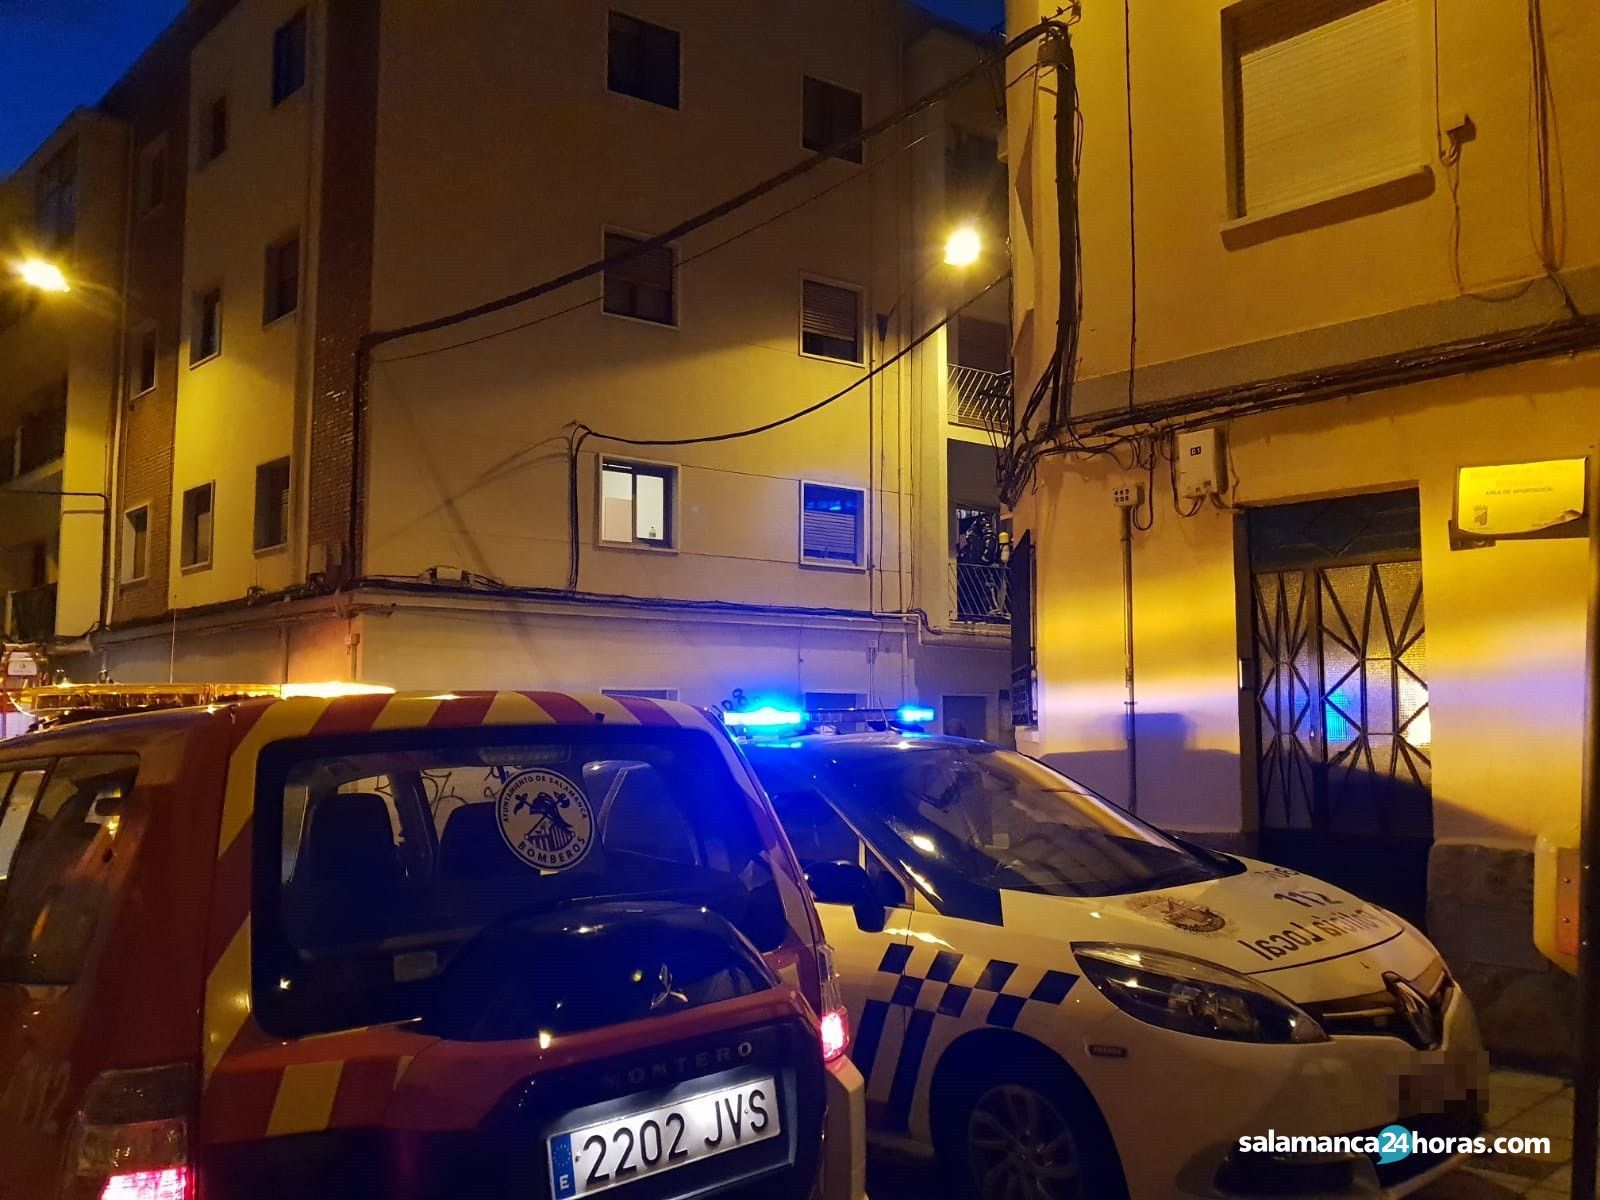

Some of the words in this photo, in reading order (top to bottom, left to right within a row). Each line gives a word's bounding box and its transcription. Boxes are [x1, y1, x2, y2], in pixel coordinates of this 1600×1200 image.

[503, 775, 534, 822] AYUNTAMIENTO
[549, 777, 588, 819] SALAMANCA
[518, 837, 586, 864] BOMBEROS
[559, 1174, 570, 1190] E
[583, 1112, 688, 1186] 2202
[704, 1089, 769, 1148] JVS
